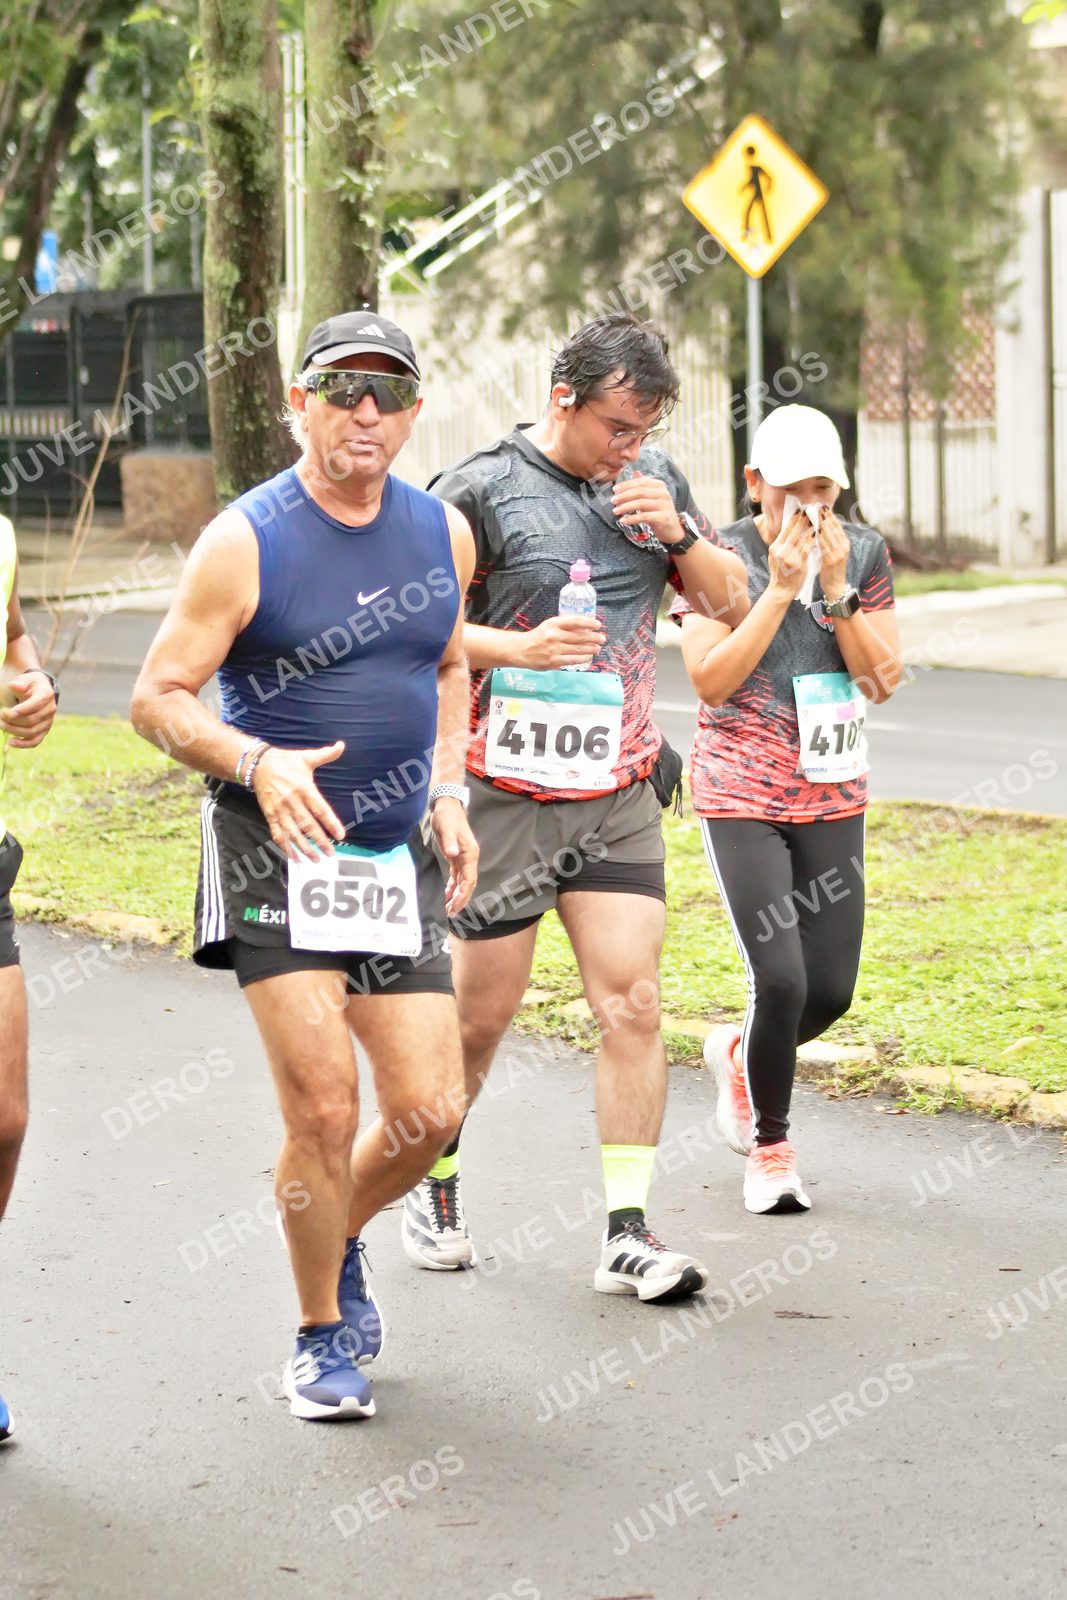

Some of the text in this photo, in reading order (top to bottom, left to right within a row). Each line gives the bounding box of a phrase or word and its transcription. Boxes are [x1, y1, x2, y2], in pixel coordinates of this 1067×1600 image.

[497, 719, 610, 761] 4106
[243, 903, 289, 924] MÉXI
[301, 879, 408, 924] 6502
